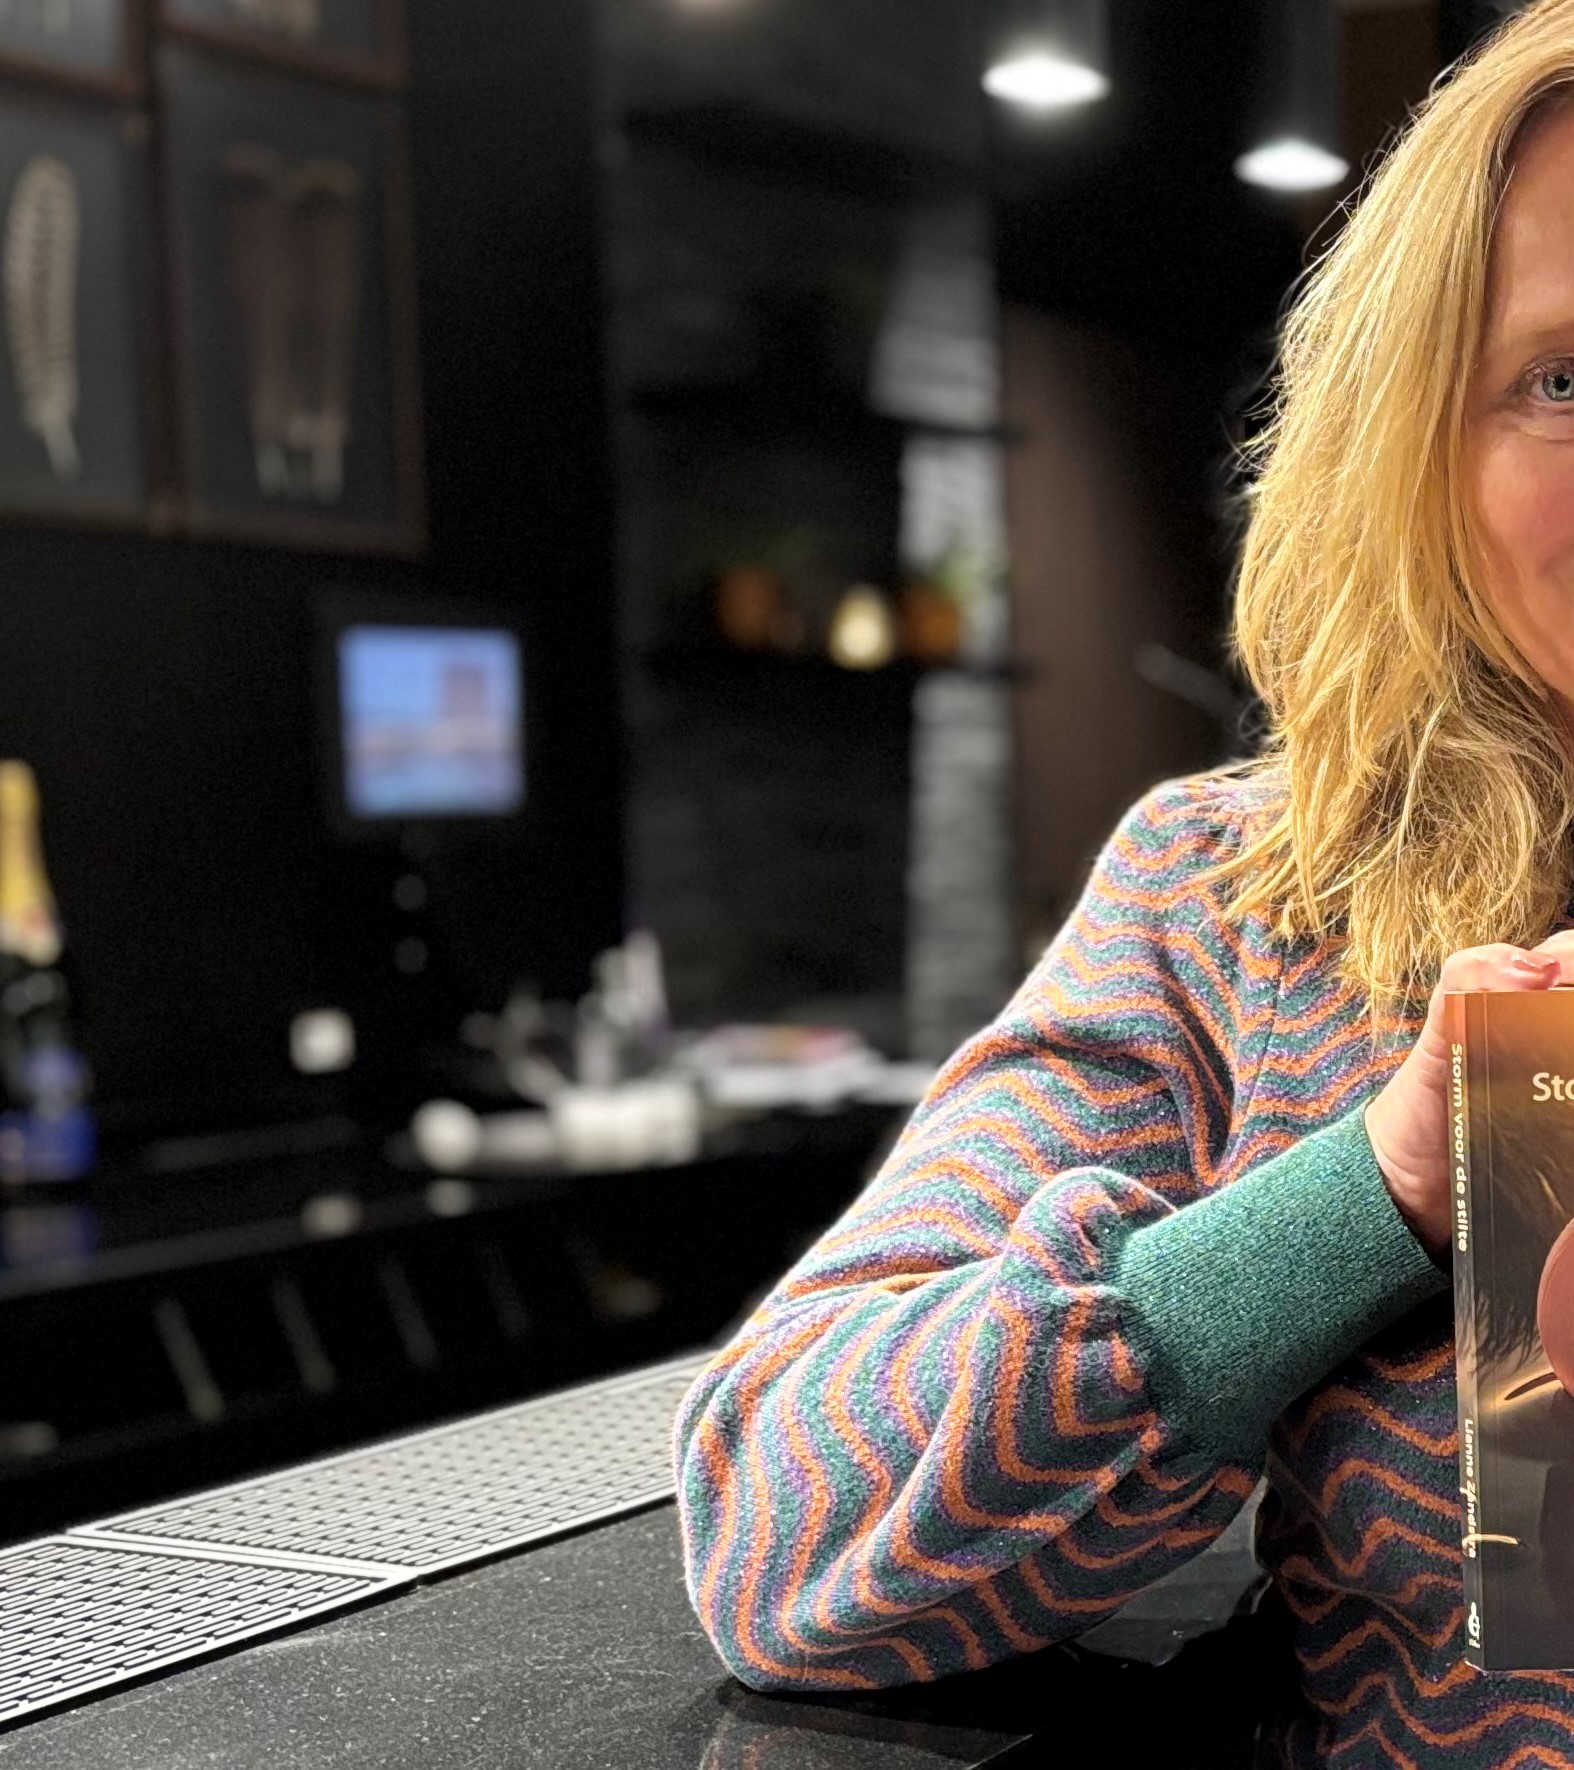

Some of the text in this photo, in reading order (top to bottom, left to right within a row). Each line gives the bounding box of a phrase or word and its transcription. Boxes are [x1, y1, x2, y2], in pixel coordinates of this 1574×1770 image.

[1452, 1043, 1469, 1252] Storm voor de stilte
[1465, 1419, 1477, 1559] Lianne Zandsra
